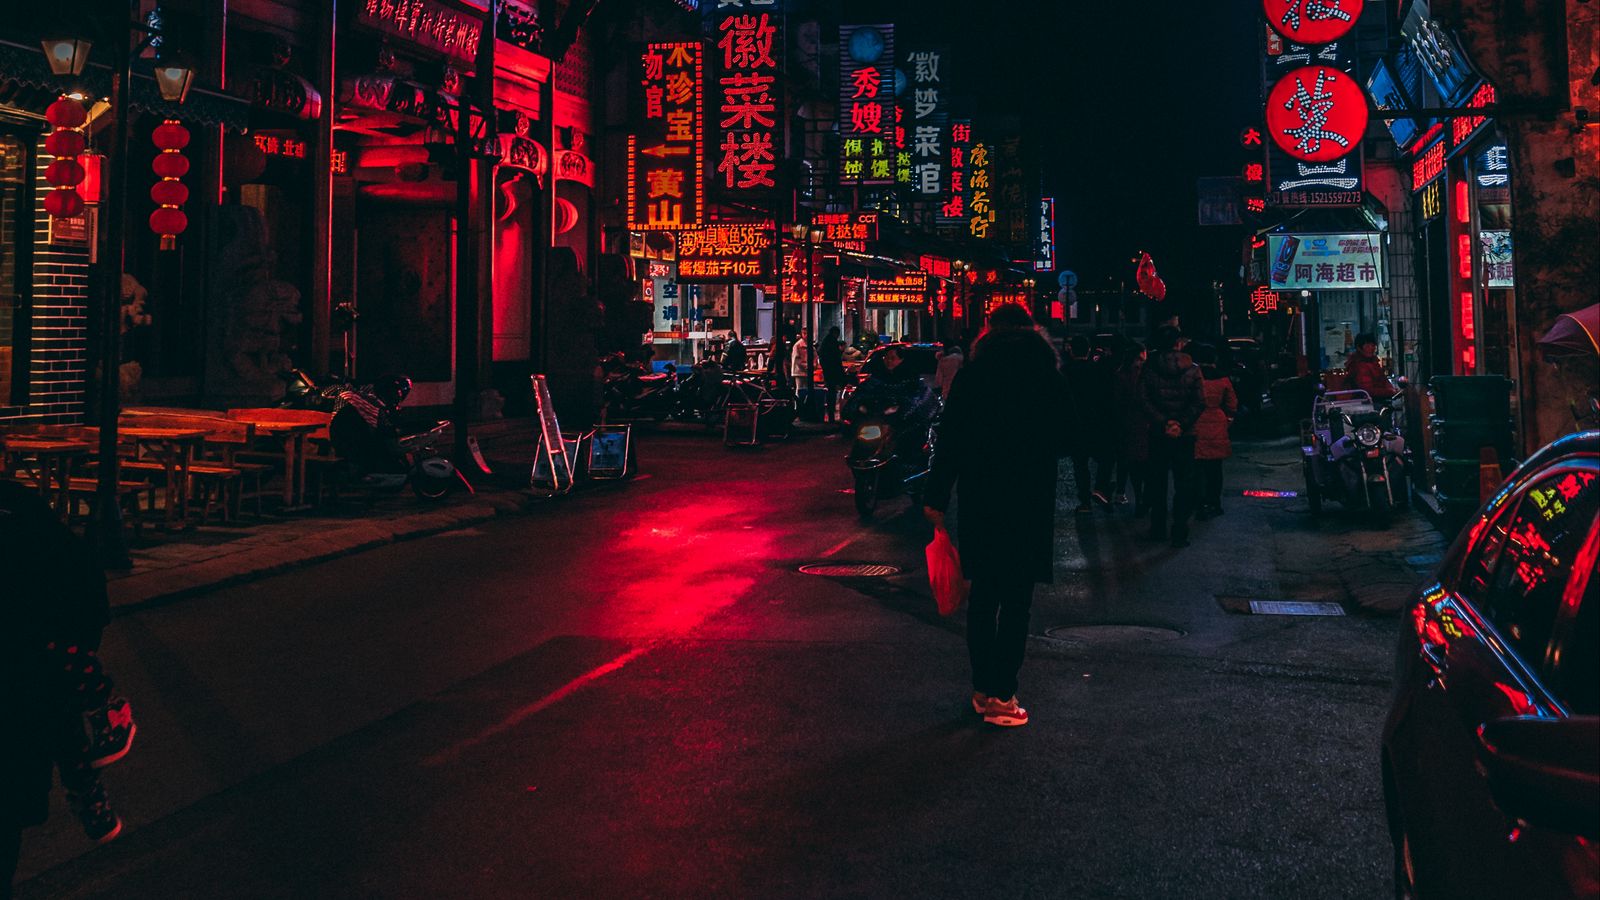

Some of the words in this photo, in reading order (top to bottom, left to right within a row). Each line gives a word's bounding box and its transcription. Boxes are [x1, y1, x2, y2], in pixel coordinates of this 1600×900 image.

[717, 13, 777, 189] 徽菜楼
[850, 66, 882, 134] 秀嫂
[646, 168, 684, 226] 黄山
[679, 261, 761, 277] 酱爆茄子10元
[1295, 262, 1377, 283] 阿海超市
